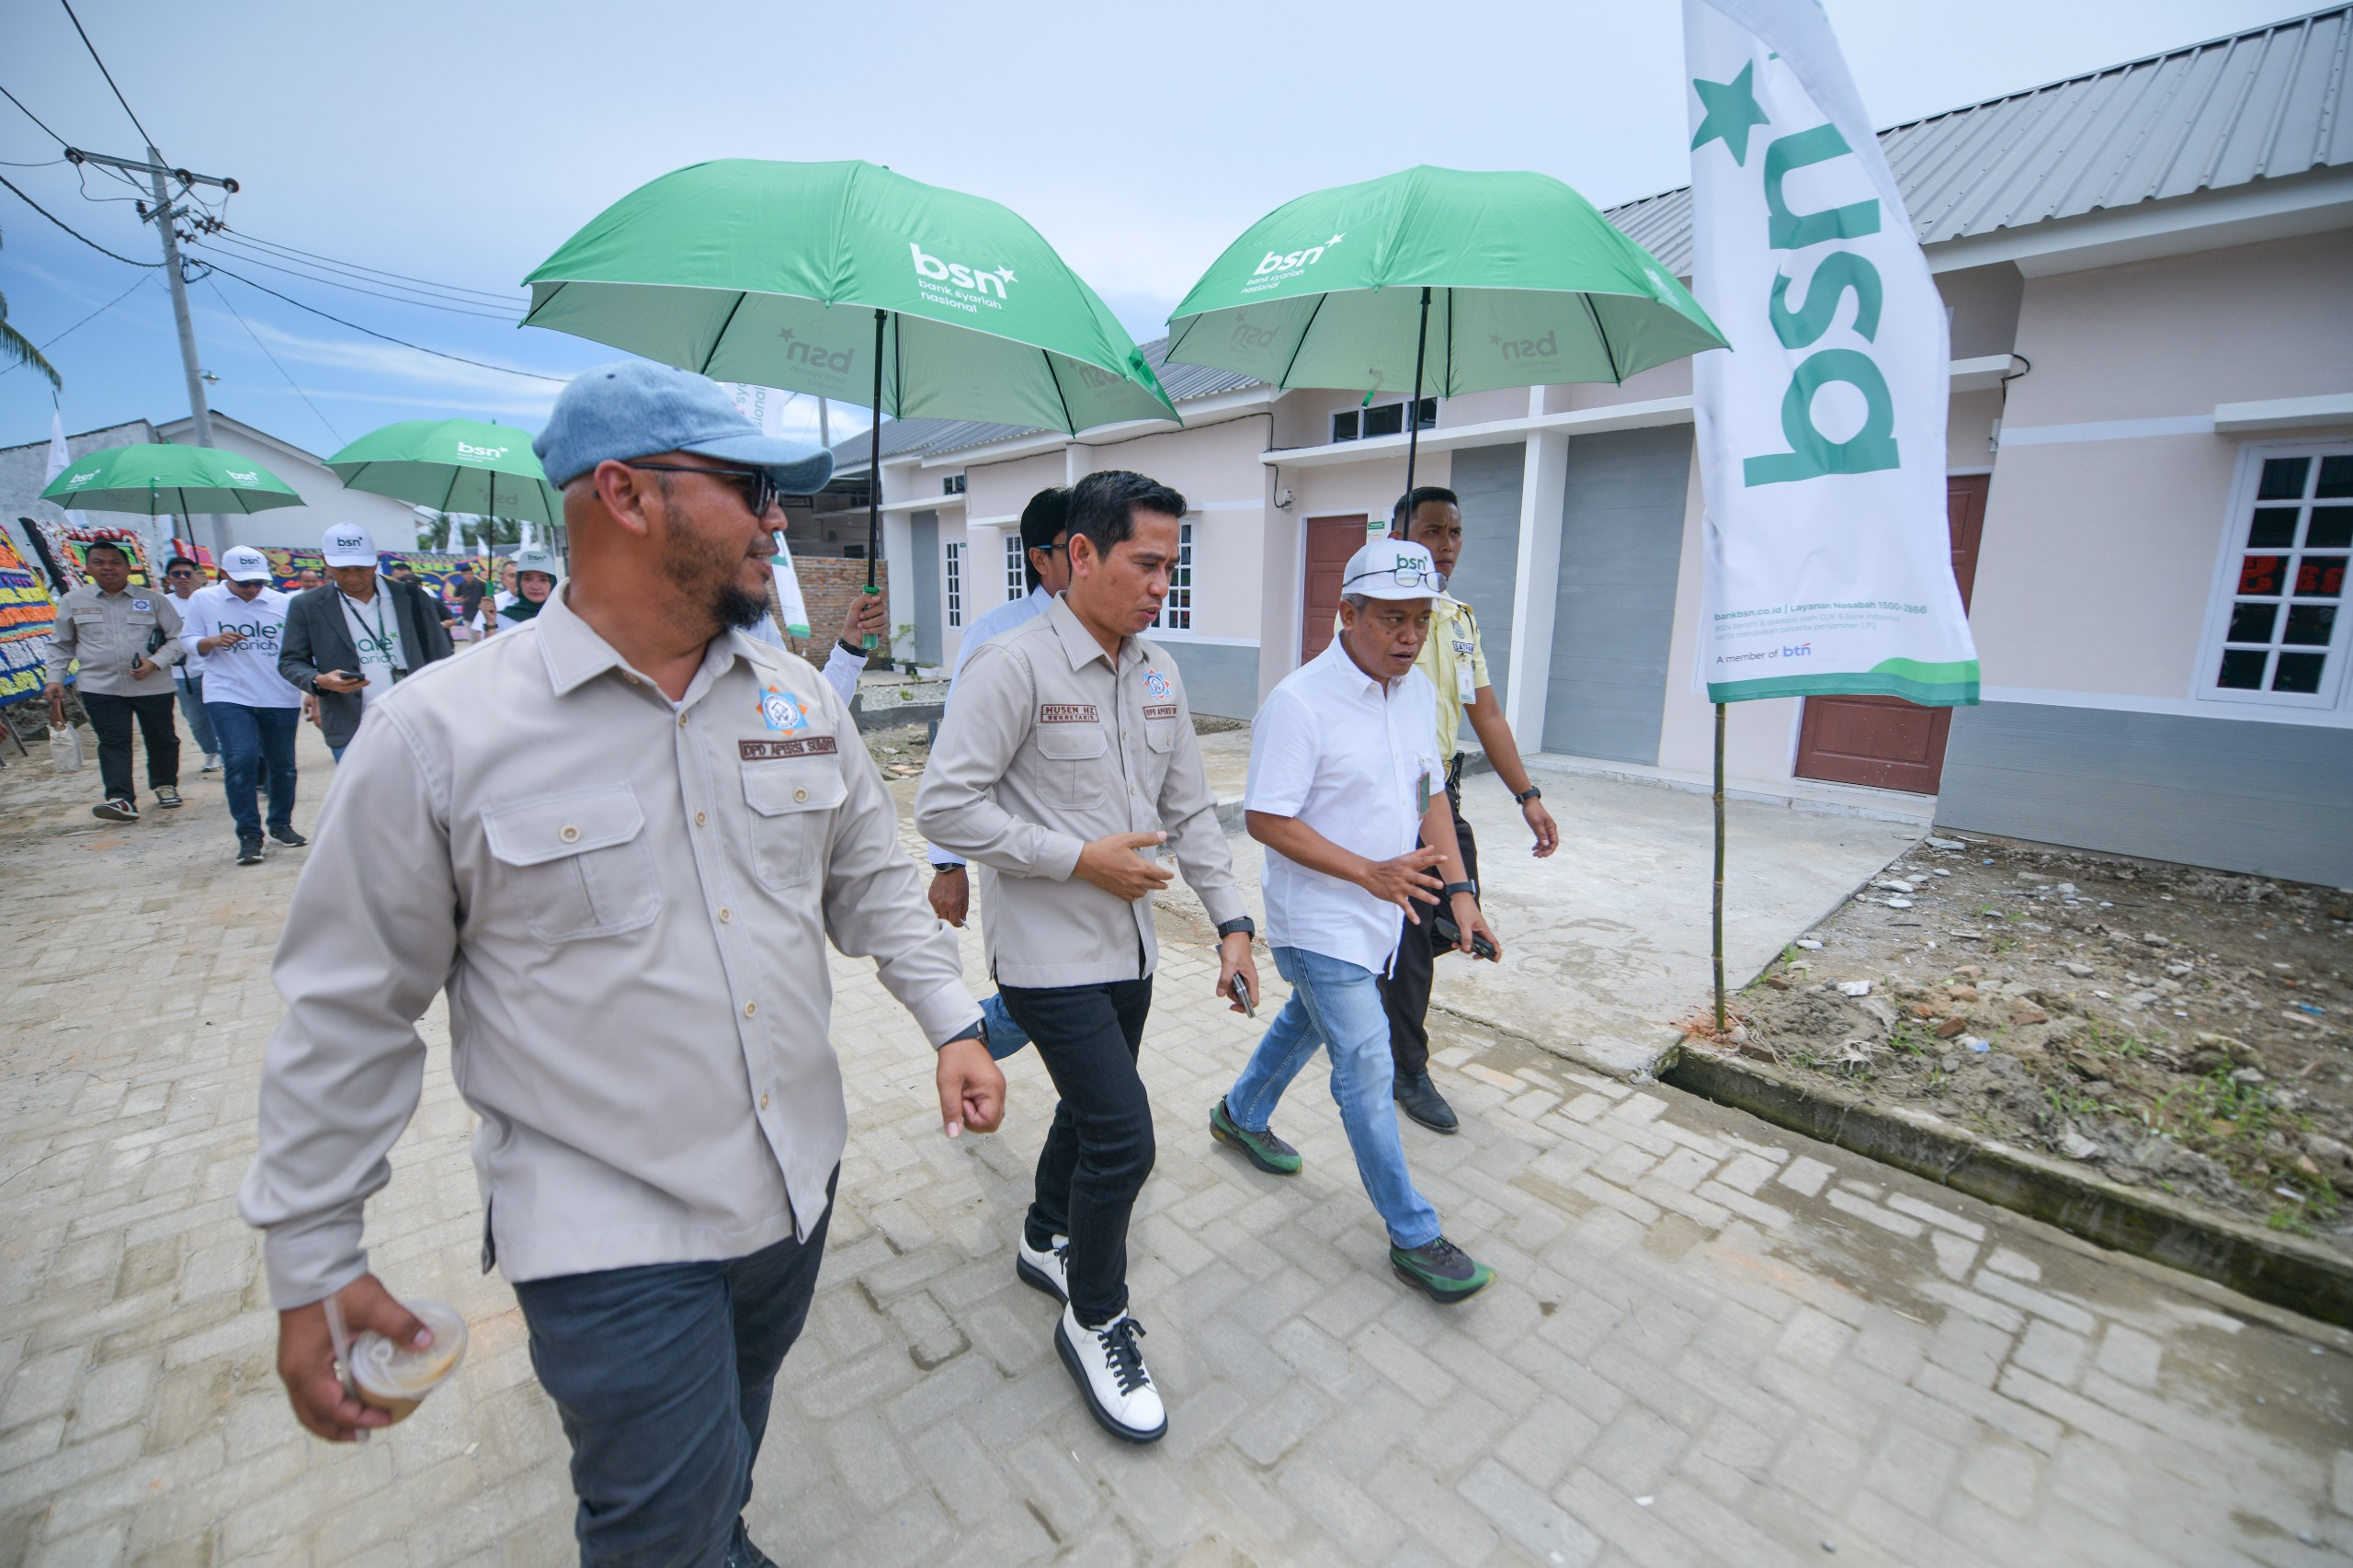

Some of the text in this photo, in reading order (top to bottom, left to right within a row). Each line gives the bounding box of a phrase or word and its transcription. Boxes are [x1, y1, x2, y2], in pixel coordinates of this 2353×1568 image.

[1253, 246, 1324, 276] bsn
[910, 243, 1007, 300] bsn
[1246, 269, 1304, 286] bank syariah
[918, 278, 1002, 310] bank syariah
[1241, 281, 1280, 294] nasional
[921, 292, 977, 313] nasional
[1744, 123, 1900, 487] bsn
[751, 386, 767, 428] sional
[458, 441, 501, 458] bsn
[226, 470, 258, 482] bsn
[337, 538, 361, 547] bsn
[239, 556, 259, 565] bsn
[1396, 553, 1426, 571] bsn
[1714, 607, 1782, 620] bankbsn.co.id
[1790, 602, 1831, 612] Layanan
[1726, 652, 1766, 663] member
[1768, 649, 1779, 658] of
[1782, 645, 1812, 657] btn
